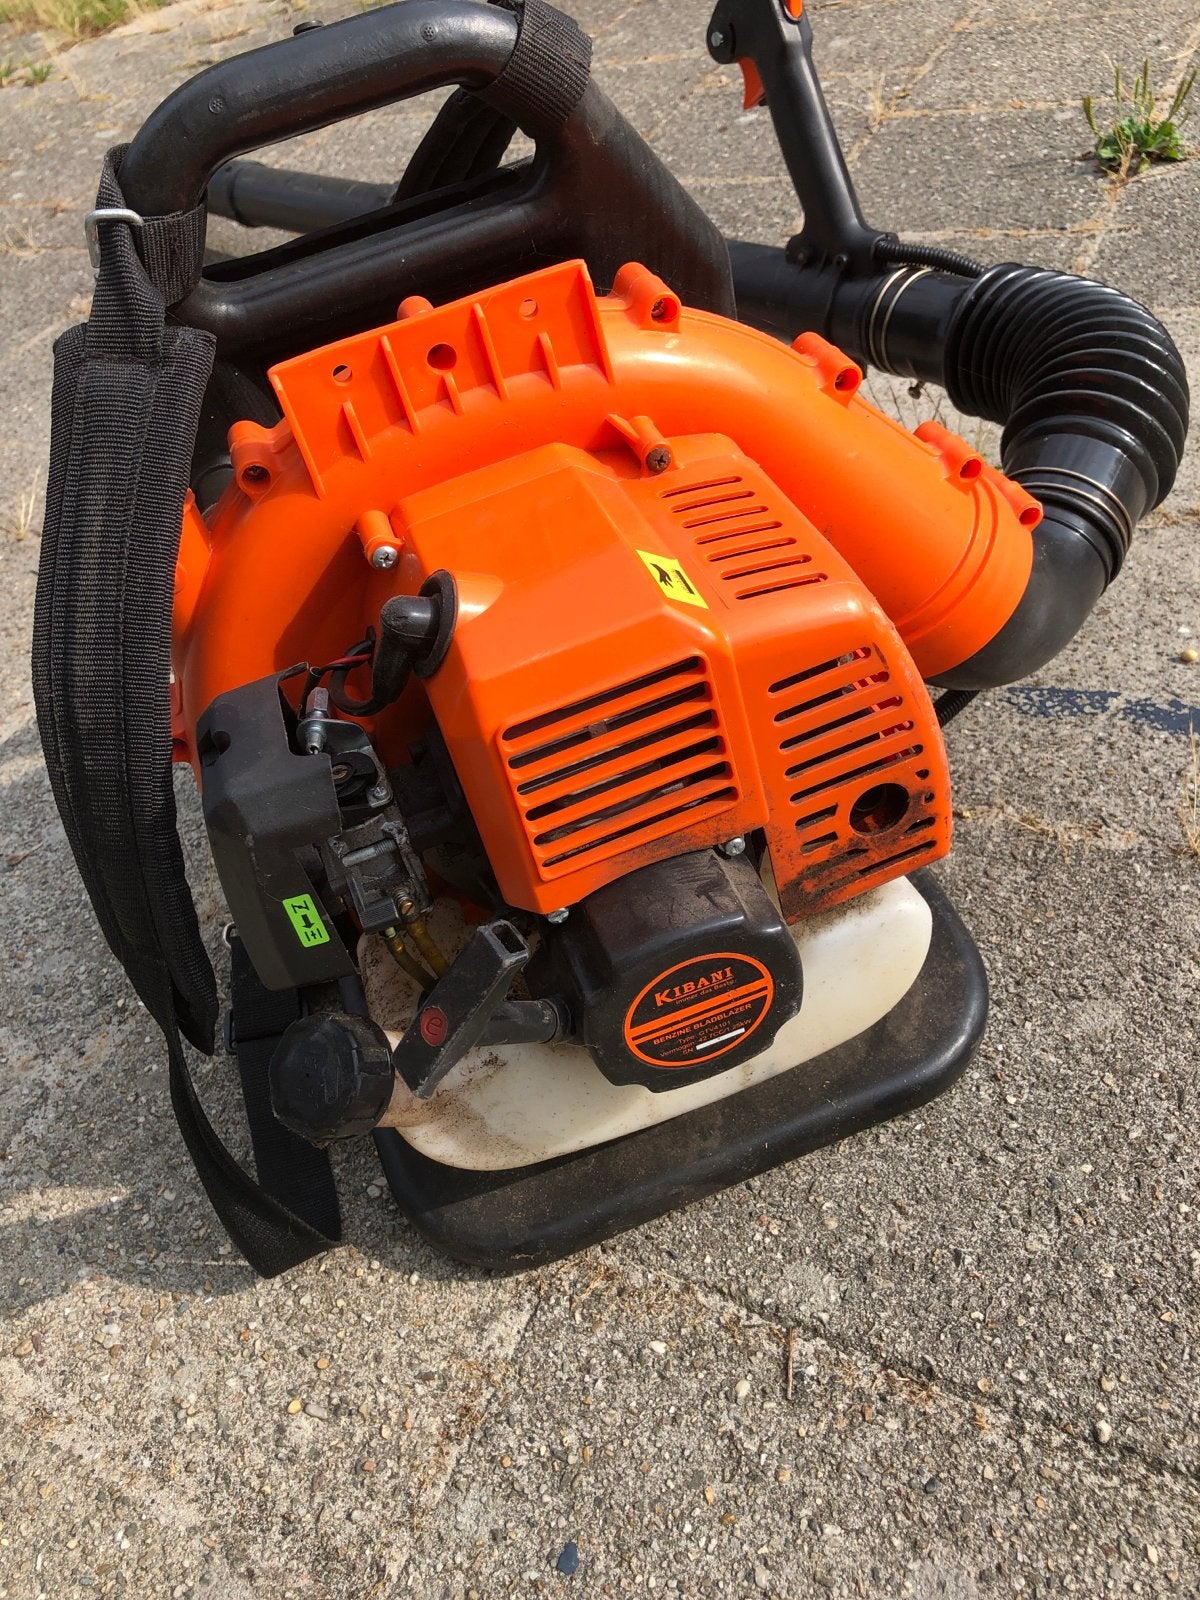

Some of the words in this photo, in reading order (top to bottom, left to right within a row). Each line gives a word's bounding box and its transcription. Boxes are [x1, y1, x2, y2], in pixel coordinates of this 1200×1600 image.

[655, 967, 733, 1007] KIBANI
[653, 1025, 692, 1046] BENZINE
[693, 1003, 752, 1030] BLADBLAZER
